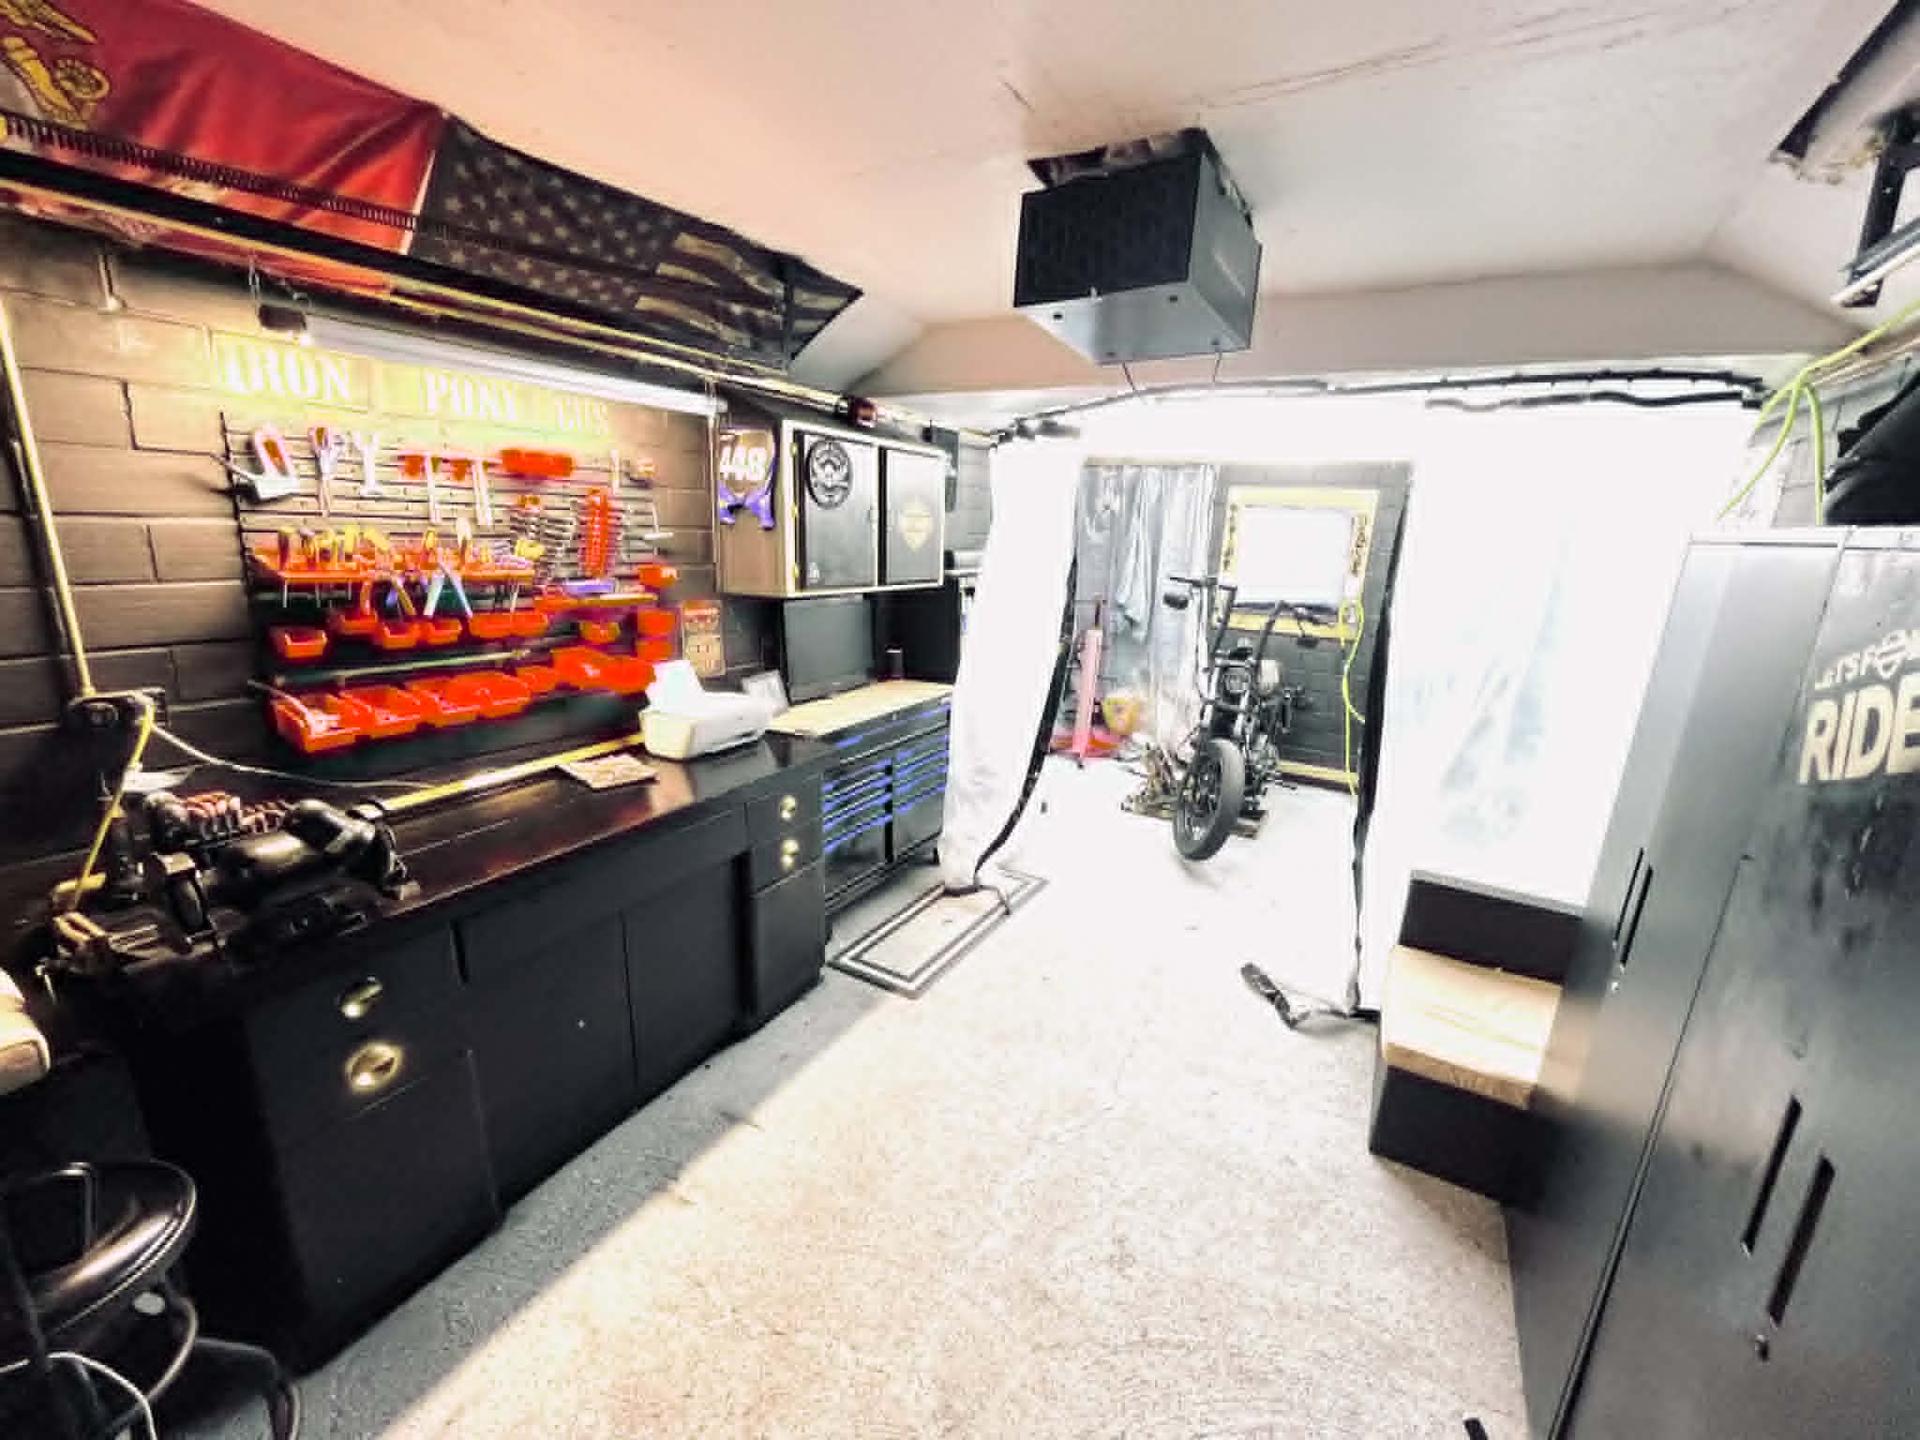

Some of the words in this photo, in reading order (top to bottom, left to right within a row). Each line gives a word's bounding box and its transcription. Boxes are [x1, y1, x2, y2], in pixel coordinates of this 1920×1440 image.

[219, 343, 357, 403] IRON
[424, 371, 519, 422] PONY
[1797, 672, 1920, 784] RIDE
